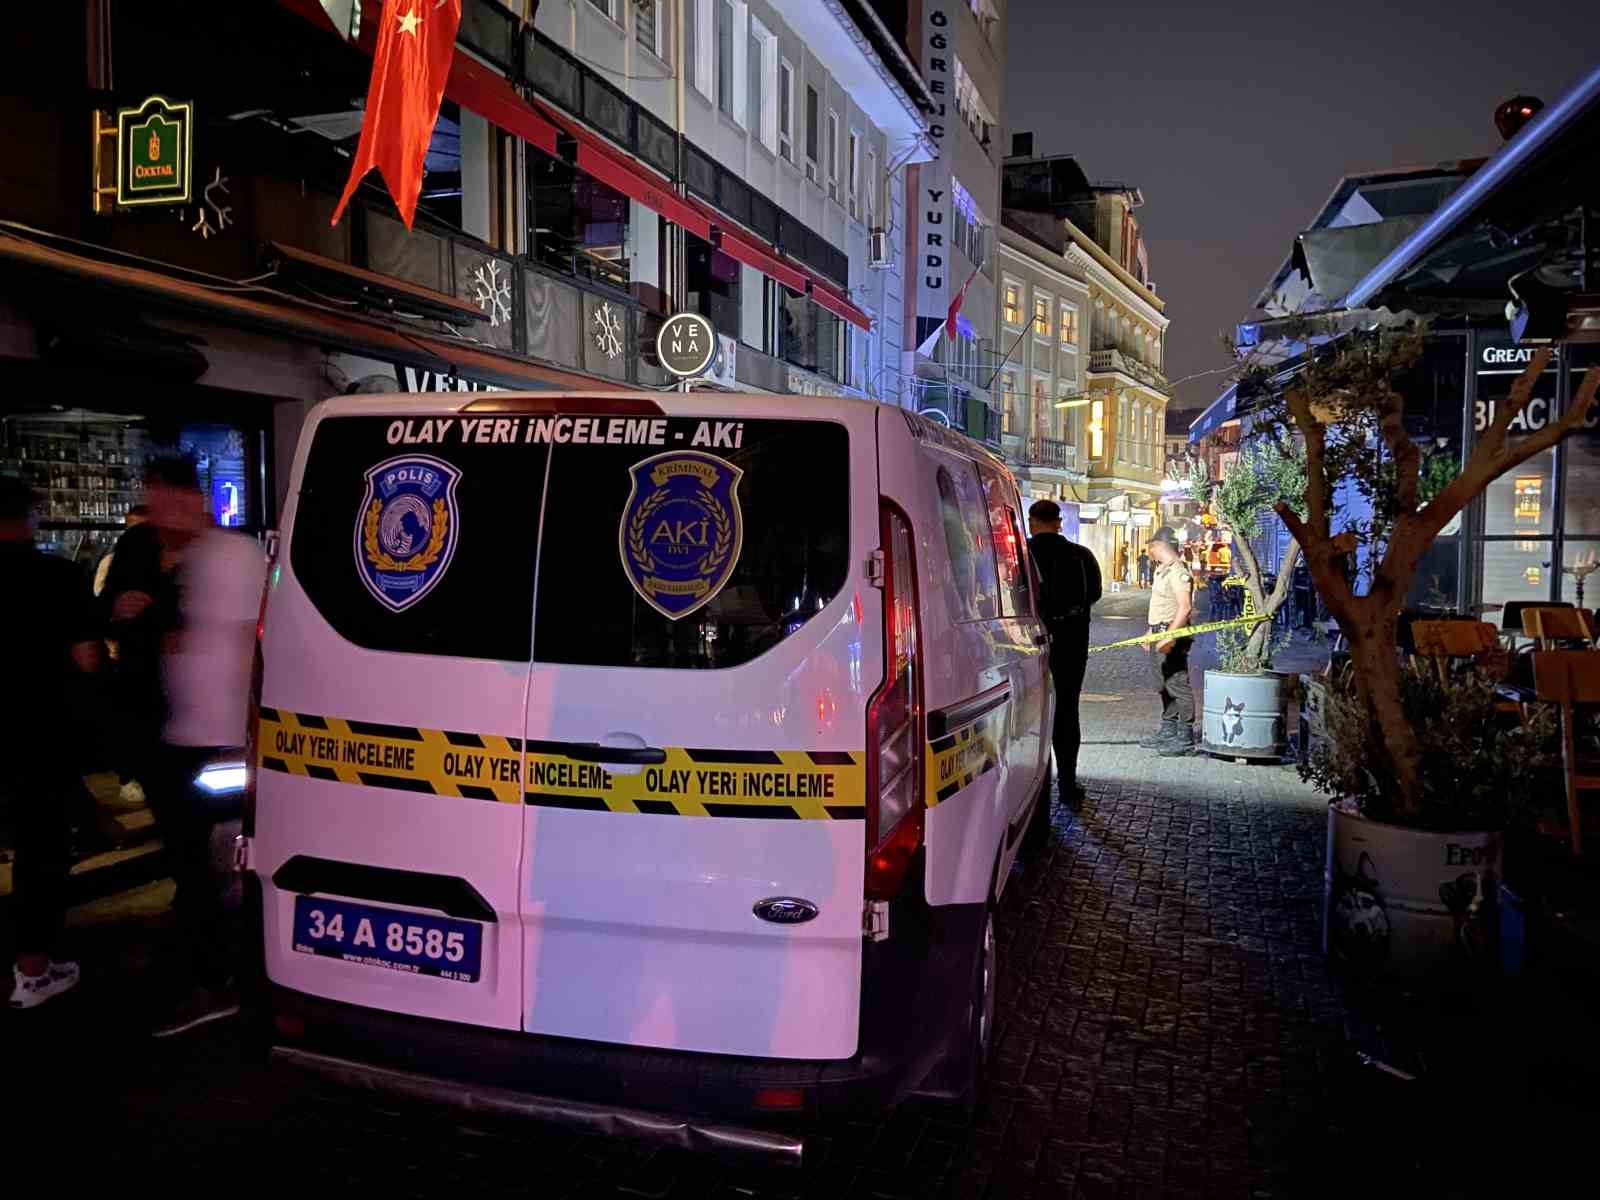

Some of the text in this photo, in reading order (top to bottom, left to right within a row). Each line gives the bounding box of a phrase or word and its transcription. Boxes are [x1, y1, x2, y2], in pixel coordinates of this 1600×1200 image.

[926, 10, 948, 290] ÖĞRENC YURDU
[404, 366, 513, 393] VEN
[386, 418, 453, 445] OLAY
[387, 469, 434, 485] POLİS
[275, 730, 307, 756] OLAY
[443, 752, 485, 779] OLAY
[645, 768, 691, 794] OLAY
[767, 902, 805, 919] Ford
[308, 909, 465, 962] 34 A 8585
